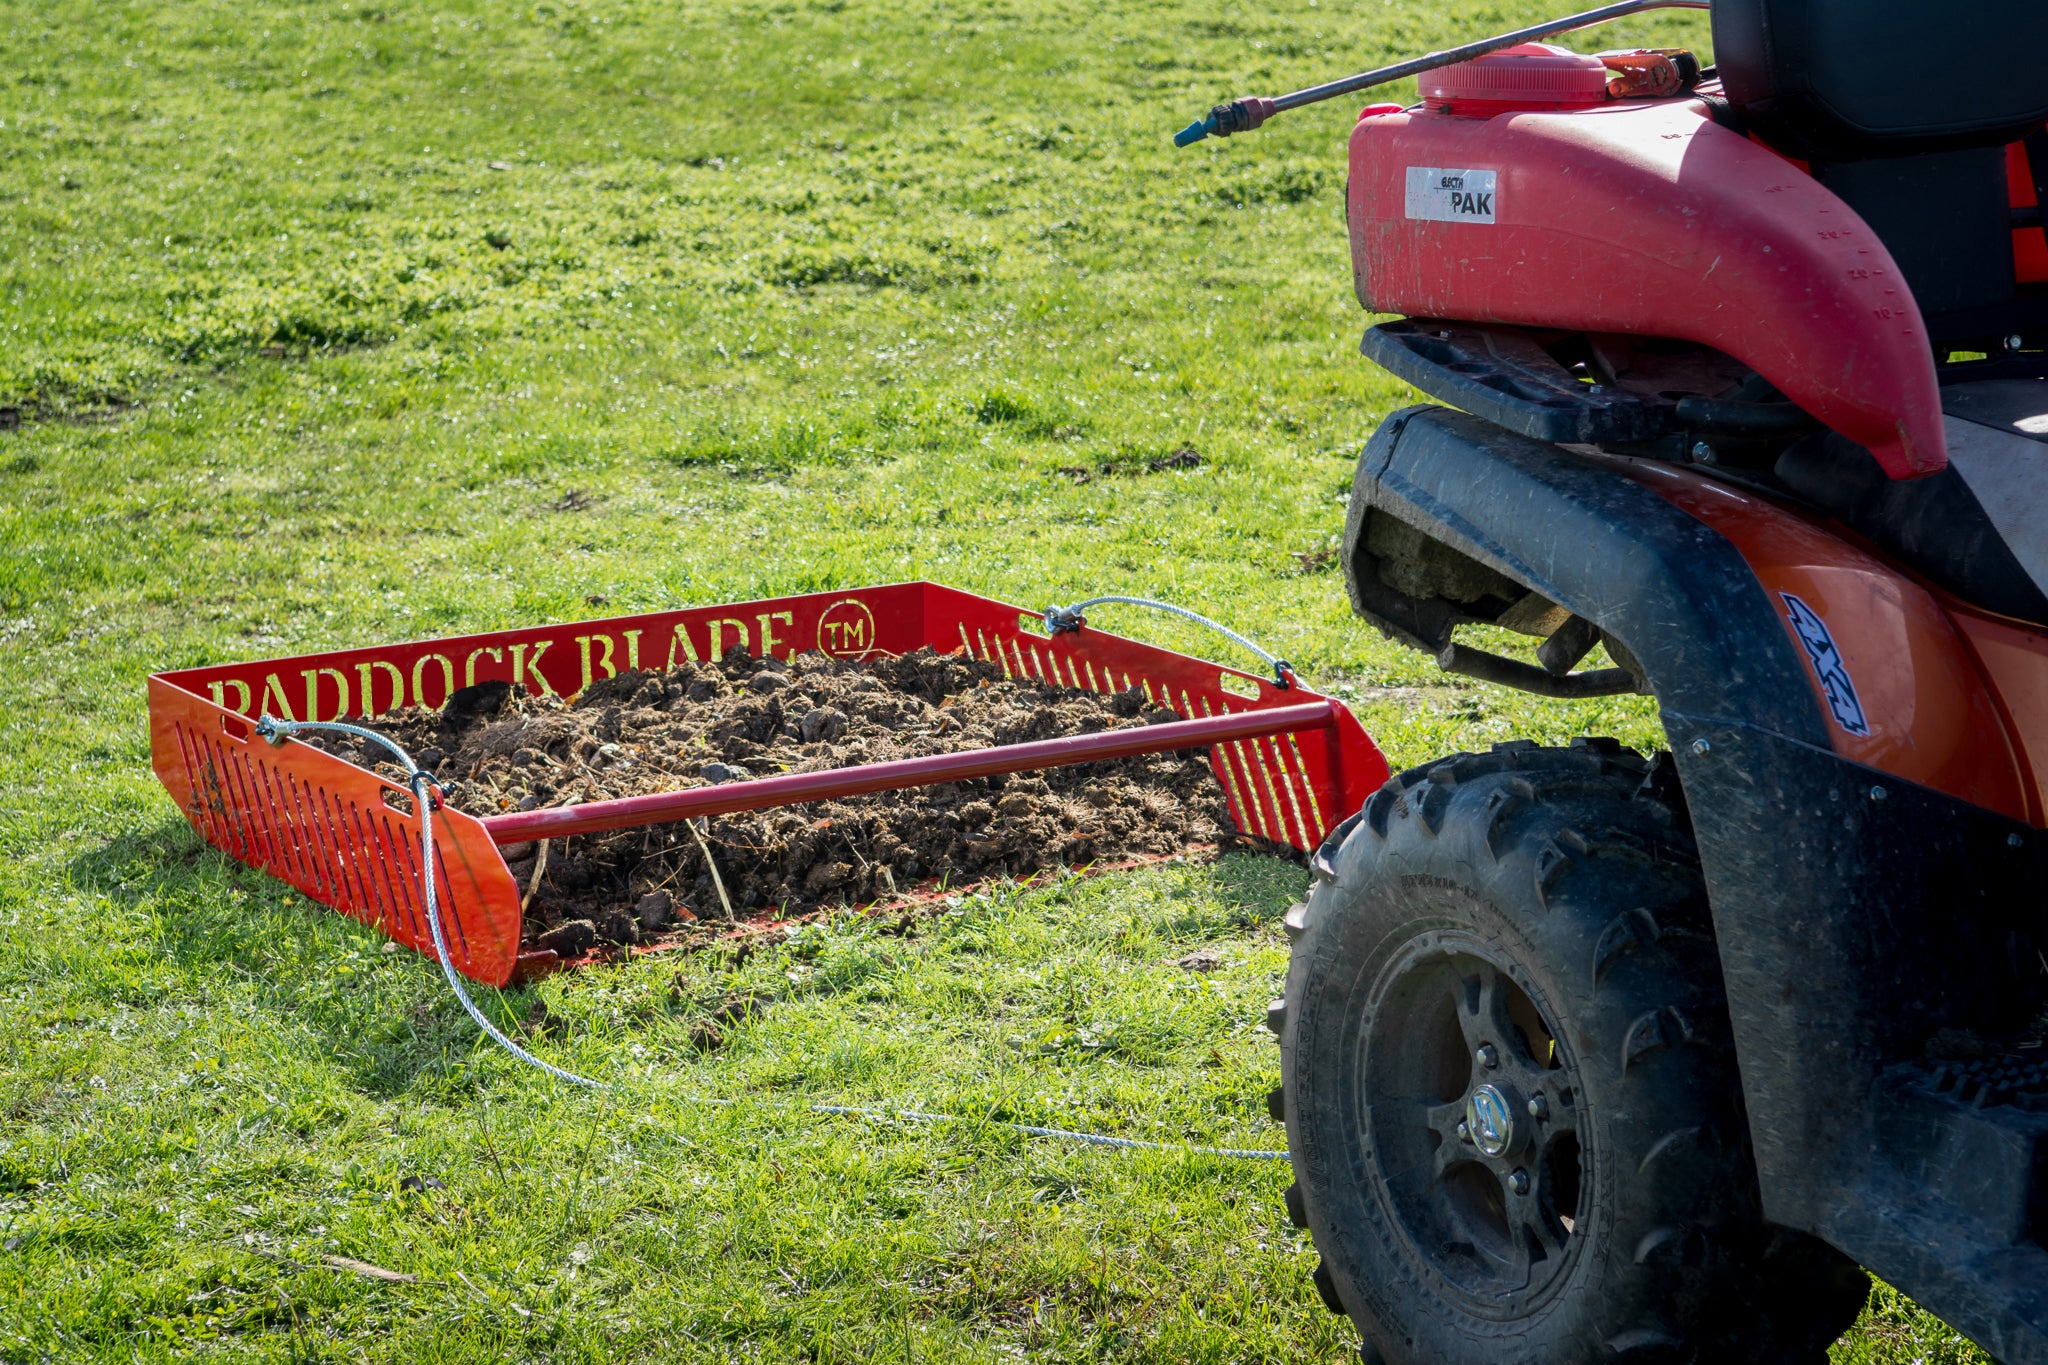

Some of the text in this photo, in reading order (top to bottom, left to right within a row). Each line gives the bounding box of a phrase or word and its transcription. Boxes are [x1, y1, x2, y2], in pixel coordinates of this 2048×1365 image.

[1451, 192, 1492, 215] PAK
[207, 640, 557, 723] PADDOCK
[575, 611, 794, 692] BLADE
